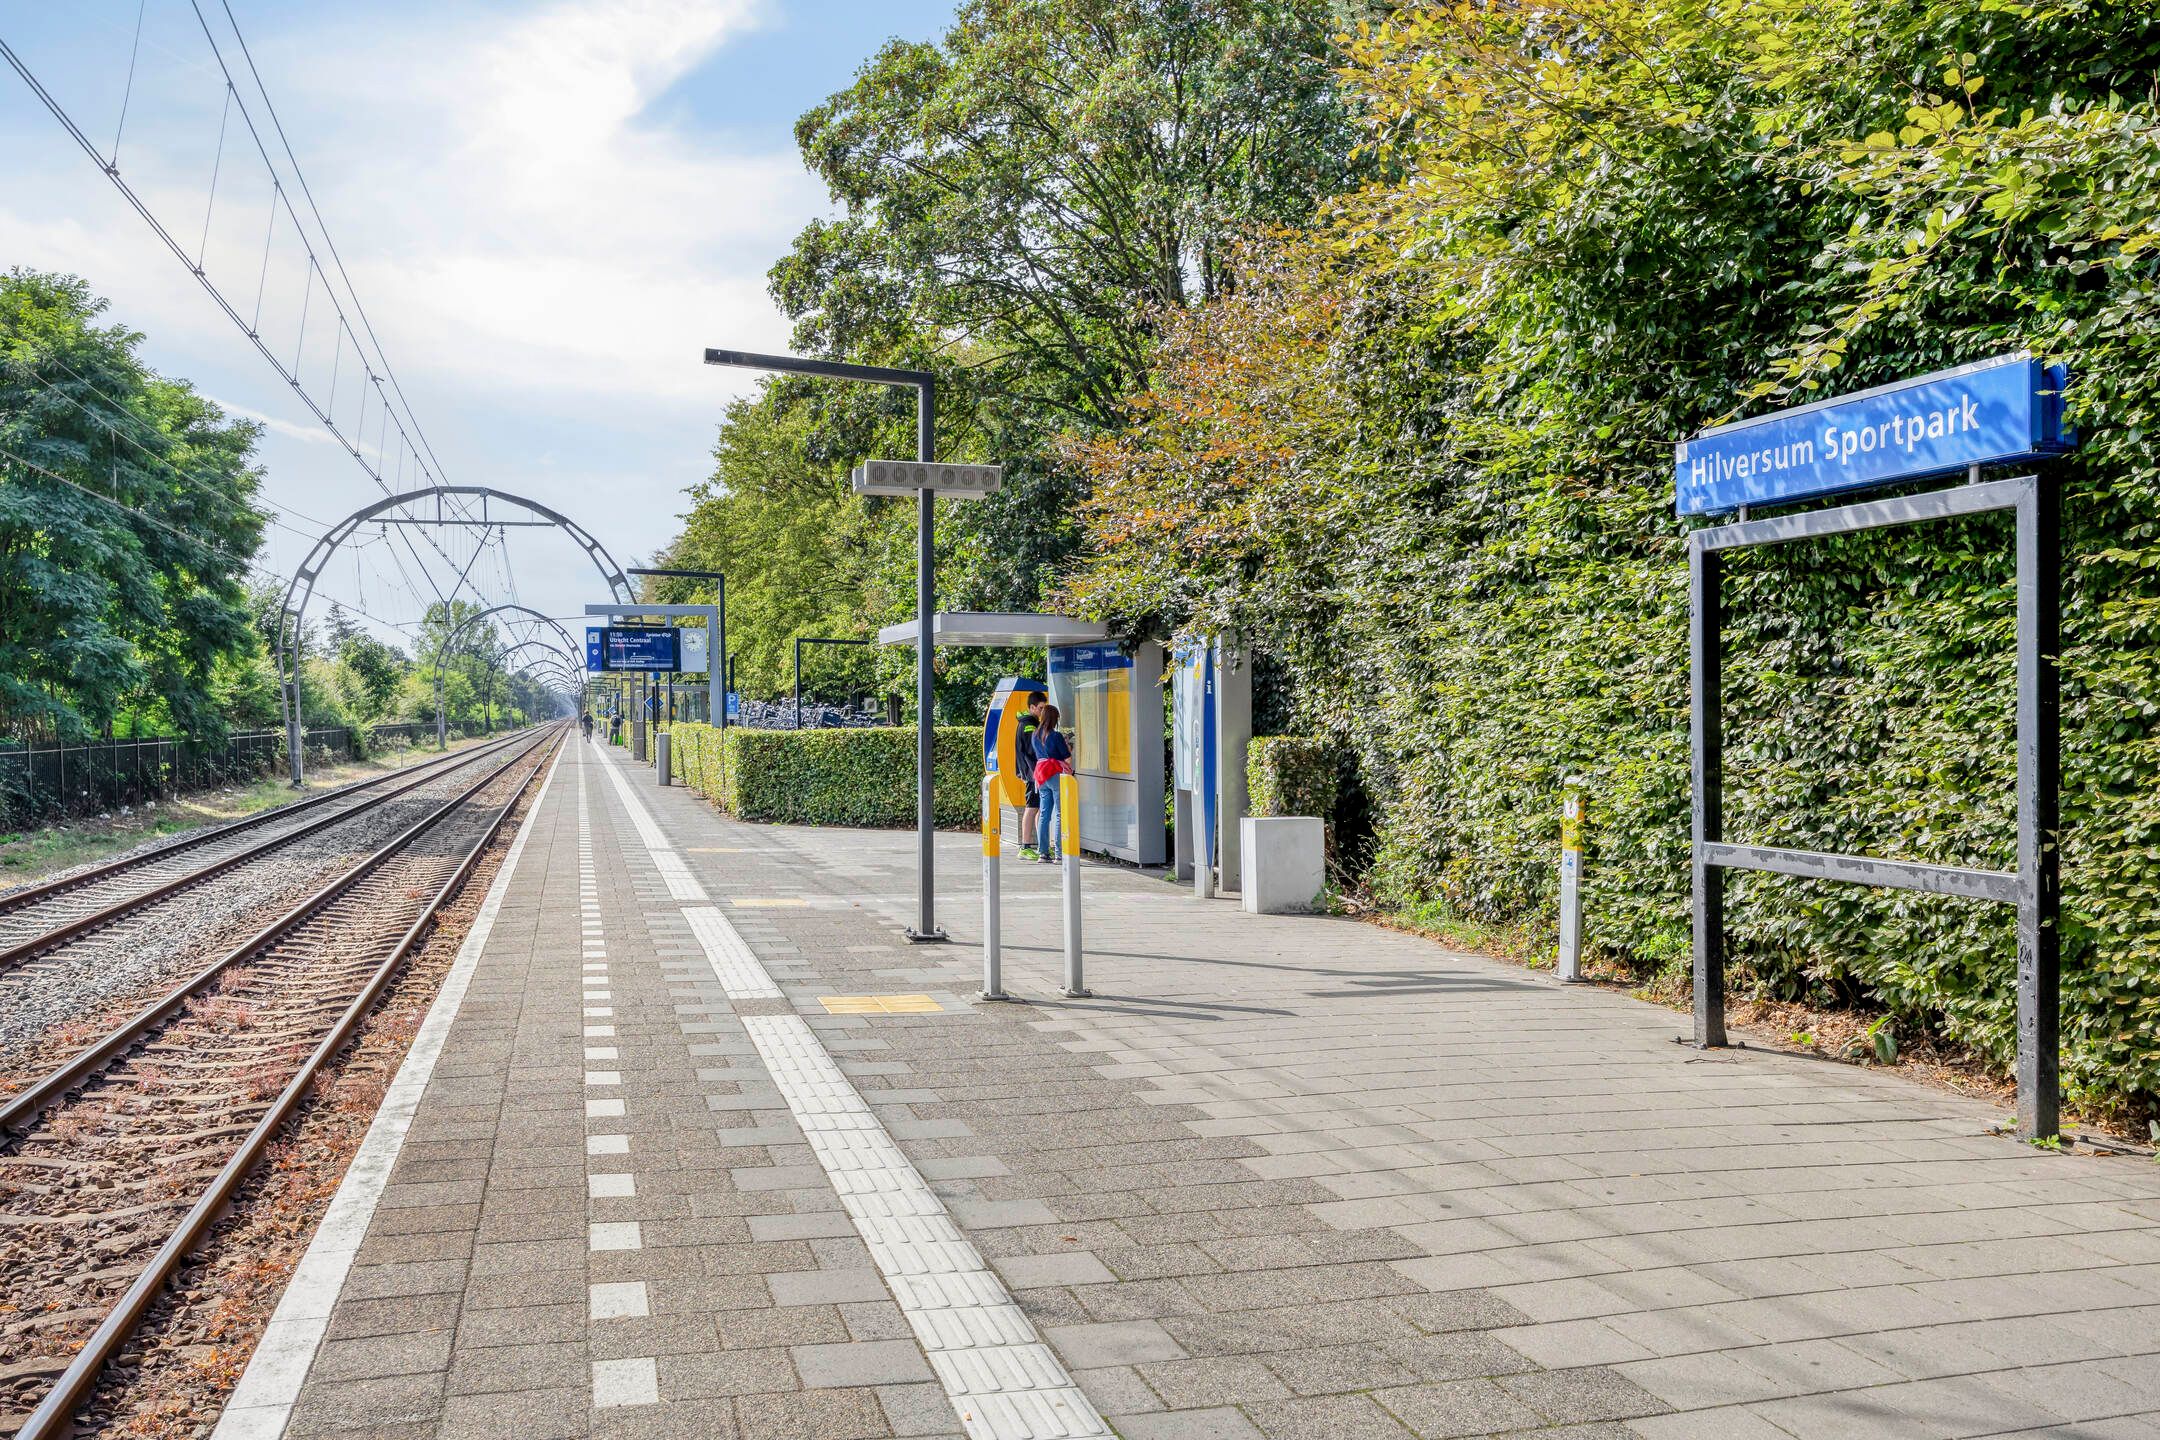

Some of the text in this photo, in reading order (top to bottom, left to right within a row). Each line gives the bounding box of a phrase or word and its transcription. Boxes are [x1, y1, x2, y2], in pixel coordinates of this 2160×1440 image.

[1691, 393, 1980, 488] Hilversum Sportpark
[728, 695, 736, 704] P
